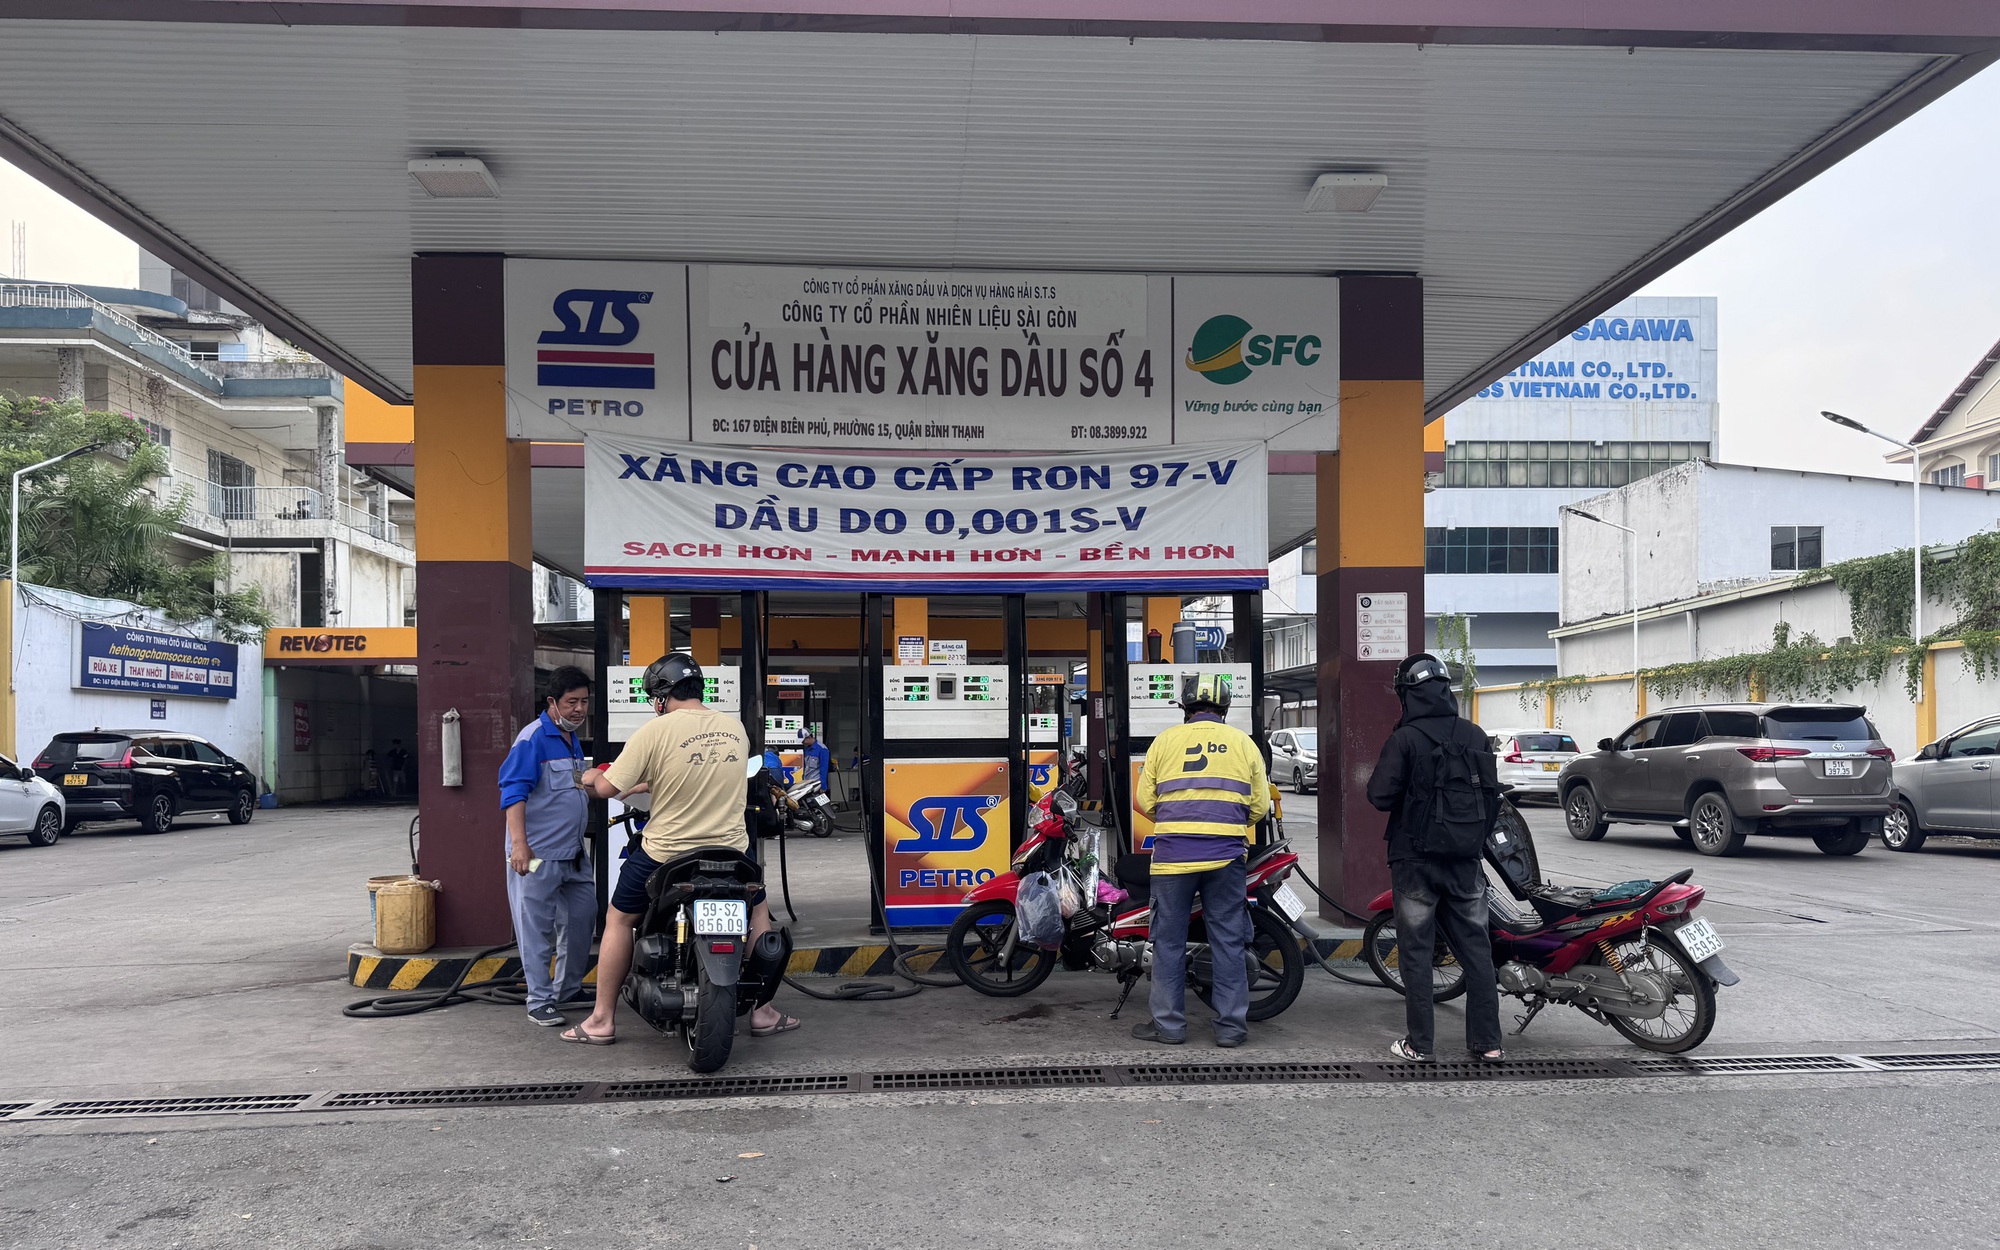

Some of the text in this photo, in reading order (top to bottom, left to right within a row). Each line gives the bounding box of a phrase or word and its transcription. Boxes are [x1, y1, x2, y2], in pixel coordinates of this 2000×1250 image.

[803, 278, 830, 294] CÔNG
[832, 282, 843, 295] TY
[846, 275, 859, 295] CỔ
[888, 280, 914, 297] XĂNG
[938, 282, 949, 297] VÀ
[951, 284, 973, 300] DỊCH
[975, 285, 987, 300] VỤ
[989, 283, 1015, 299] HÀNG
[1017, 281, 1033, 299] HẢI
[1035, 286, 1056, 299] S.T.S
[537, 289, 654, 346] STS
[782, 298, 1077, 330] CÔNG TY CỔ PHẦN NHIÊN LIỆU SÀI GÒN
[1571, 318, 1695, 342] SAGAWA
[711, 322, 1154, 398] CỬA HÀNG XĂNG DẦU SỐ 4
[1244, 334, 1322, 366] SFC
[1509, 382, 1601, 398] VIETNAM
[548, 398, 644, 417] PETRO
[1184, 400, 1322, 415] Vững bước cùng bạn
[712, 416, 1148, 442] ĐC: 167 ĐIỆN BIÊN PHỦ, PHƯỜNG 15, QUẬN BÌNH THẠNH ĐT: 08.3899.922
[618, 452, 1238, 492] XĂNG CAO CẤP RON 97-V
[714, 494, 1148, 540] DẦU DO 0,001S-V
[623, 541, 722, 560] SẠCH
[738, 545, 813, 561] HƠN
[851, 549, 956, 565] MẠNH
[970, 547, 1042, 562] HƠN
[1079, 541, 1150, 561] BỀN
[1164, 543, 1235, 560] HƠN
[126, 631, 145, 643] CÔNG
[146, 635, 153, 644] TY
[153, 636, 168, 646] TNHH
[193, 643, 208, 651] KHOA
[109, 642, 210, 666] hethongchamsocxe.com
[94, 659, 118, 674] RỬA XE
[130, 666, 144, 676] THAY
[171, 668, 184, 680] BÌNH
[223, 676, 229, 685] XE
[680, 731, 741, 749] WOODSTOCK
[1207, 742, 1228, 754] be
[893, 795, 1001, 853] STS
[899, 868, 996, 887] PETRO
[702, 902, 738, 917] 59-S2
[698, 918, 743, 933] 856.09
[1680, 920, 1709, 944] 76-B1
[1688, 933, 1723, 961] 259.53
